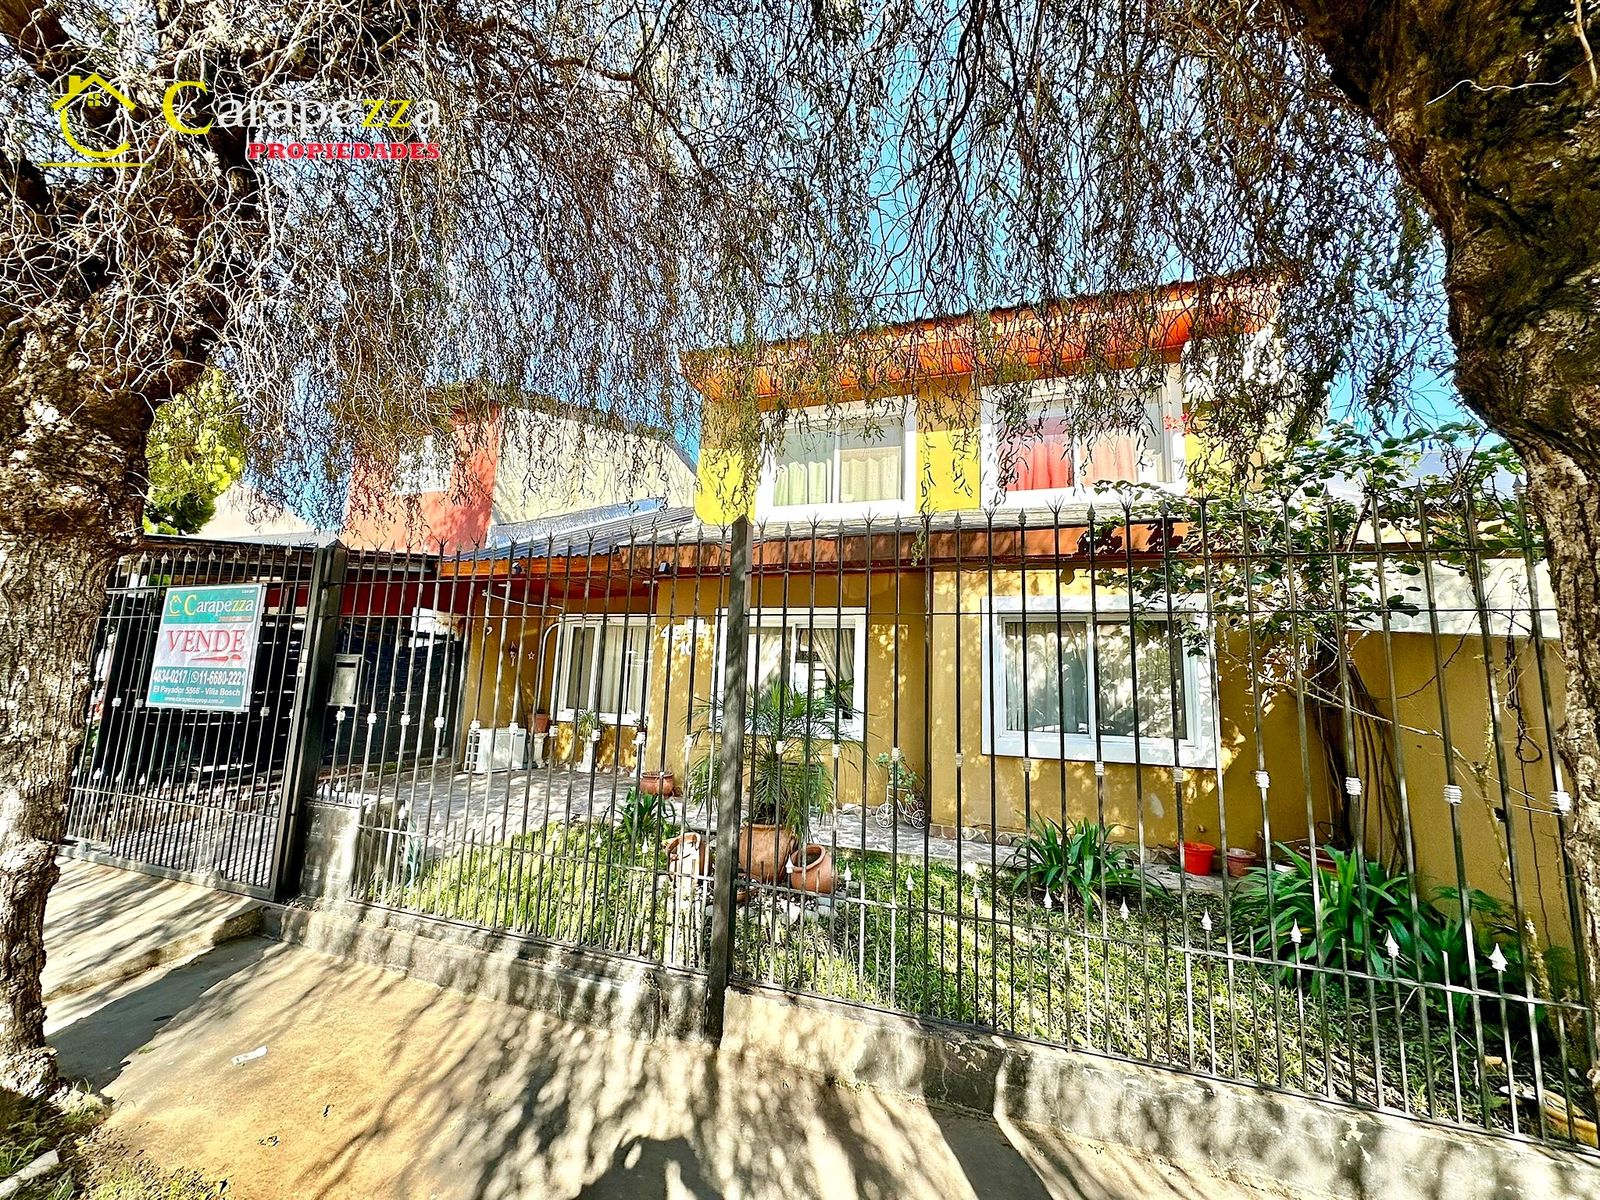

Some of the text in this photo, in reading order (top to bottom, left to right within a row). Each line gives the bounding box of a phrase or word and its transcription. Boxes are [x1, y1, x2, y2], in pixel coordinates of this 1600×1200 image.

[184, 595, 254, 616] Carapezza
[166, 629, 246, 653] VENDE
[160, 686, 185, 695] Payador
[205, 687, 219, 696] Villa
[219, 688, 241, 697] Bosch
